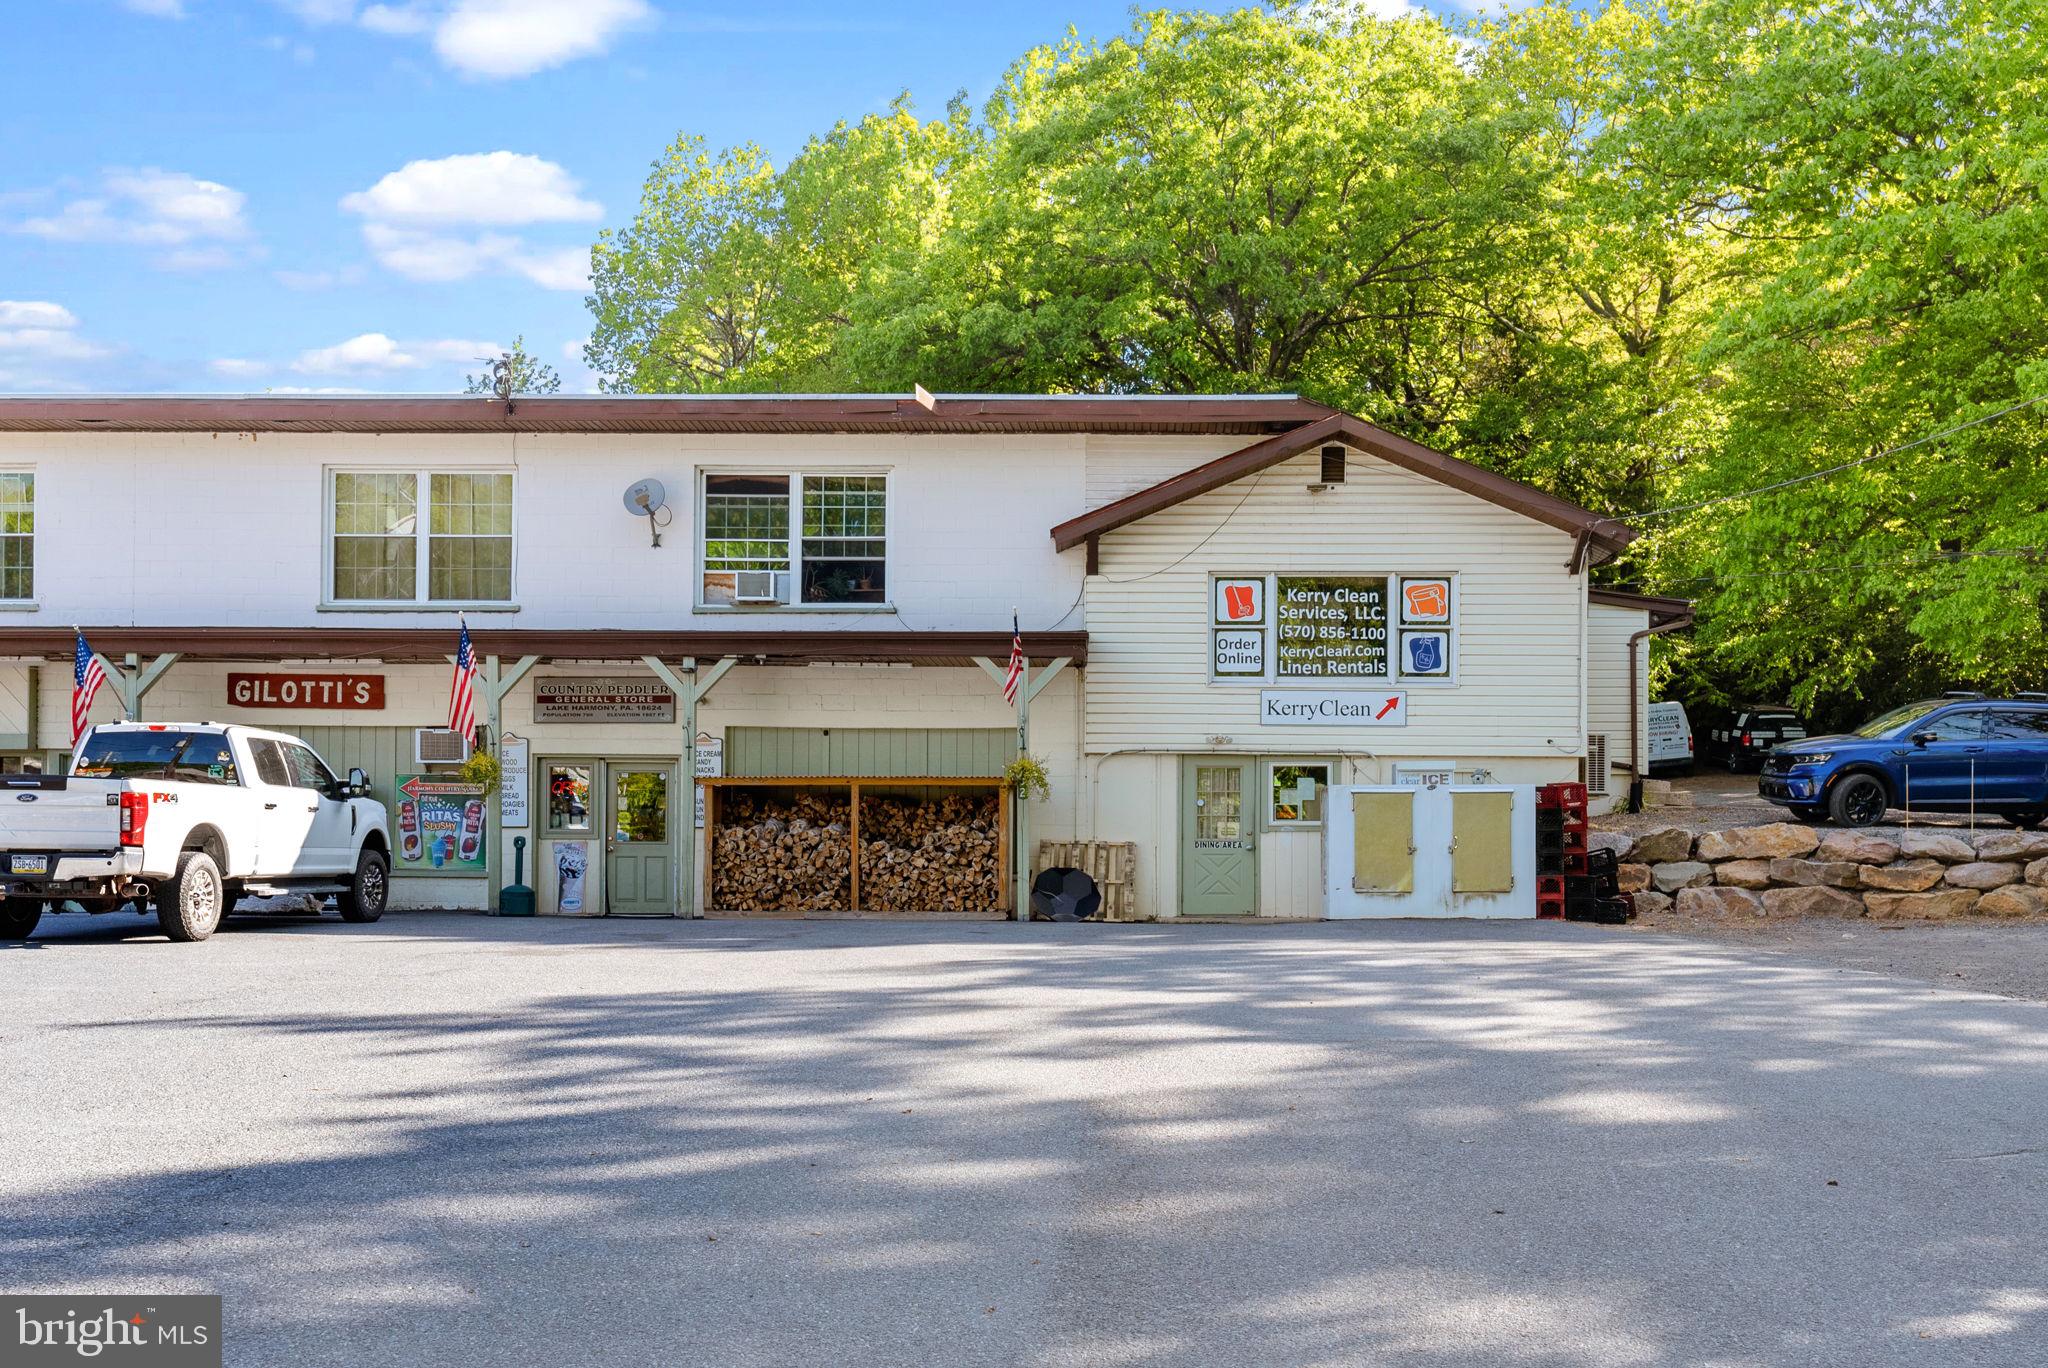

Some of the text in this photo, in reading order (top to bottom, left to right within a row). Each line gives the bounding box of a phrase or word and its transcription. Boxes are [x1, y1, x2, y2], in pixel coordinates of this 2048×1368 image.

[1287, 588, 1379, 605] Kerry Clean
[1279, 605, 1386, 621] Services, LLC.
[1279, 625, 1386, 640] (570) 856-1100
[1218, 638, 1257, 650] Order
[1217, 652, 1261, 664] Online
[1280, 645, 1385, 660] KerryClean.Com
[1279, 659, 1386, 674] Linen Rentals
[235, 678, 371, 704] GILOTTI'S
[540, 685, 669, 694] COUNTRY PEDDLER
[1267, 699, 1371, 720] KerryClean
[1422, 773, 1449, 785] ICE
[153, 792, 178, 803] FX4
[421, 811, 460, 821] RITAS
[424, 820, 457, 831] SLUSHY
